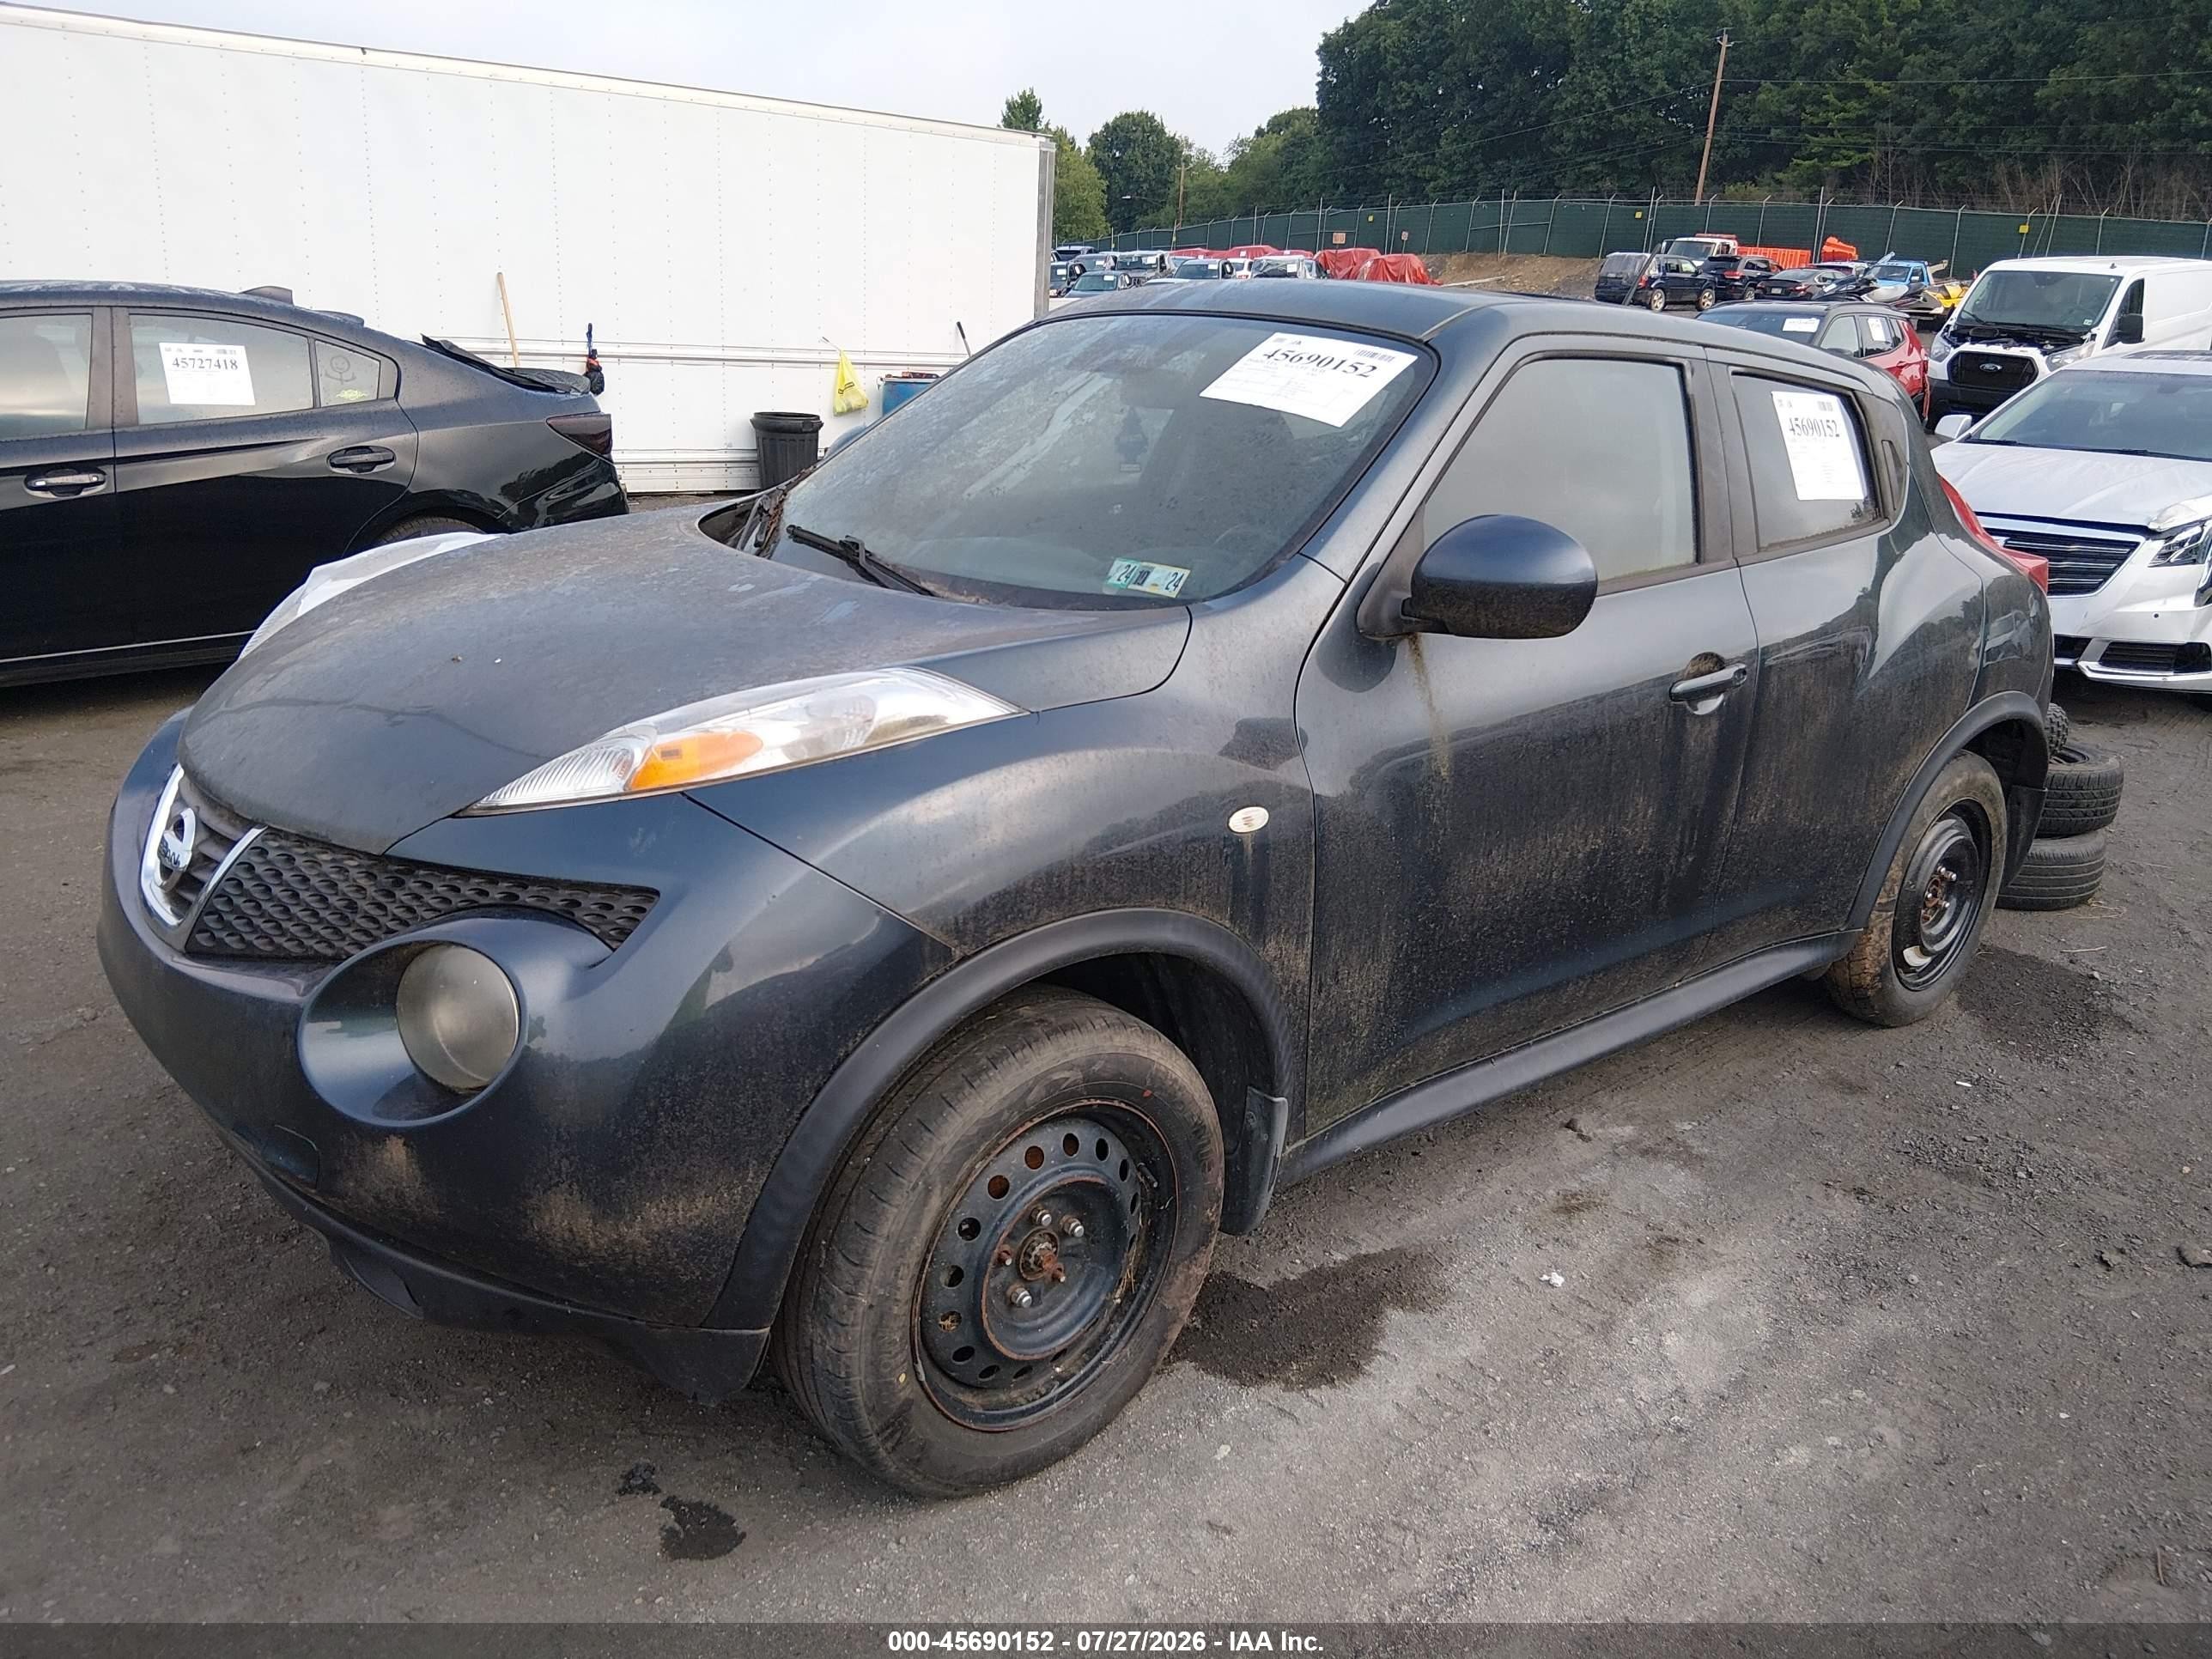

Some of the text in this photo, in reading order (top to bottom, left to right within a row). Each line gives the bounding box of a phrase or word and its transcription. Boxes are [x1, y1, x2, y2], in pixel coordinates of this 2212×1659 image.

[172, 356, 239, 370] 45727418
[1262, 348, 1377, 378] 45690152
[1789, 417, 1839, 437] 45690152
[1165, 572, 1184, 592] 24
